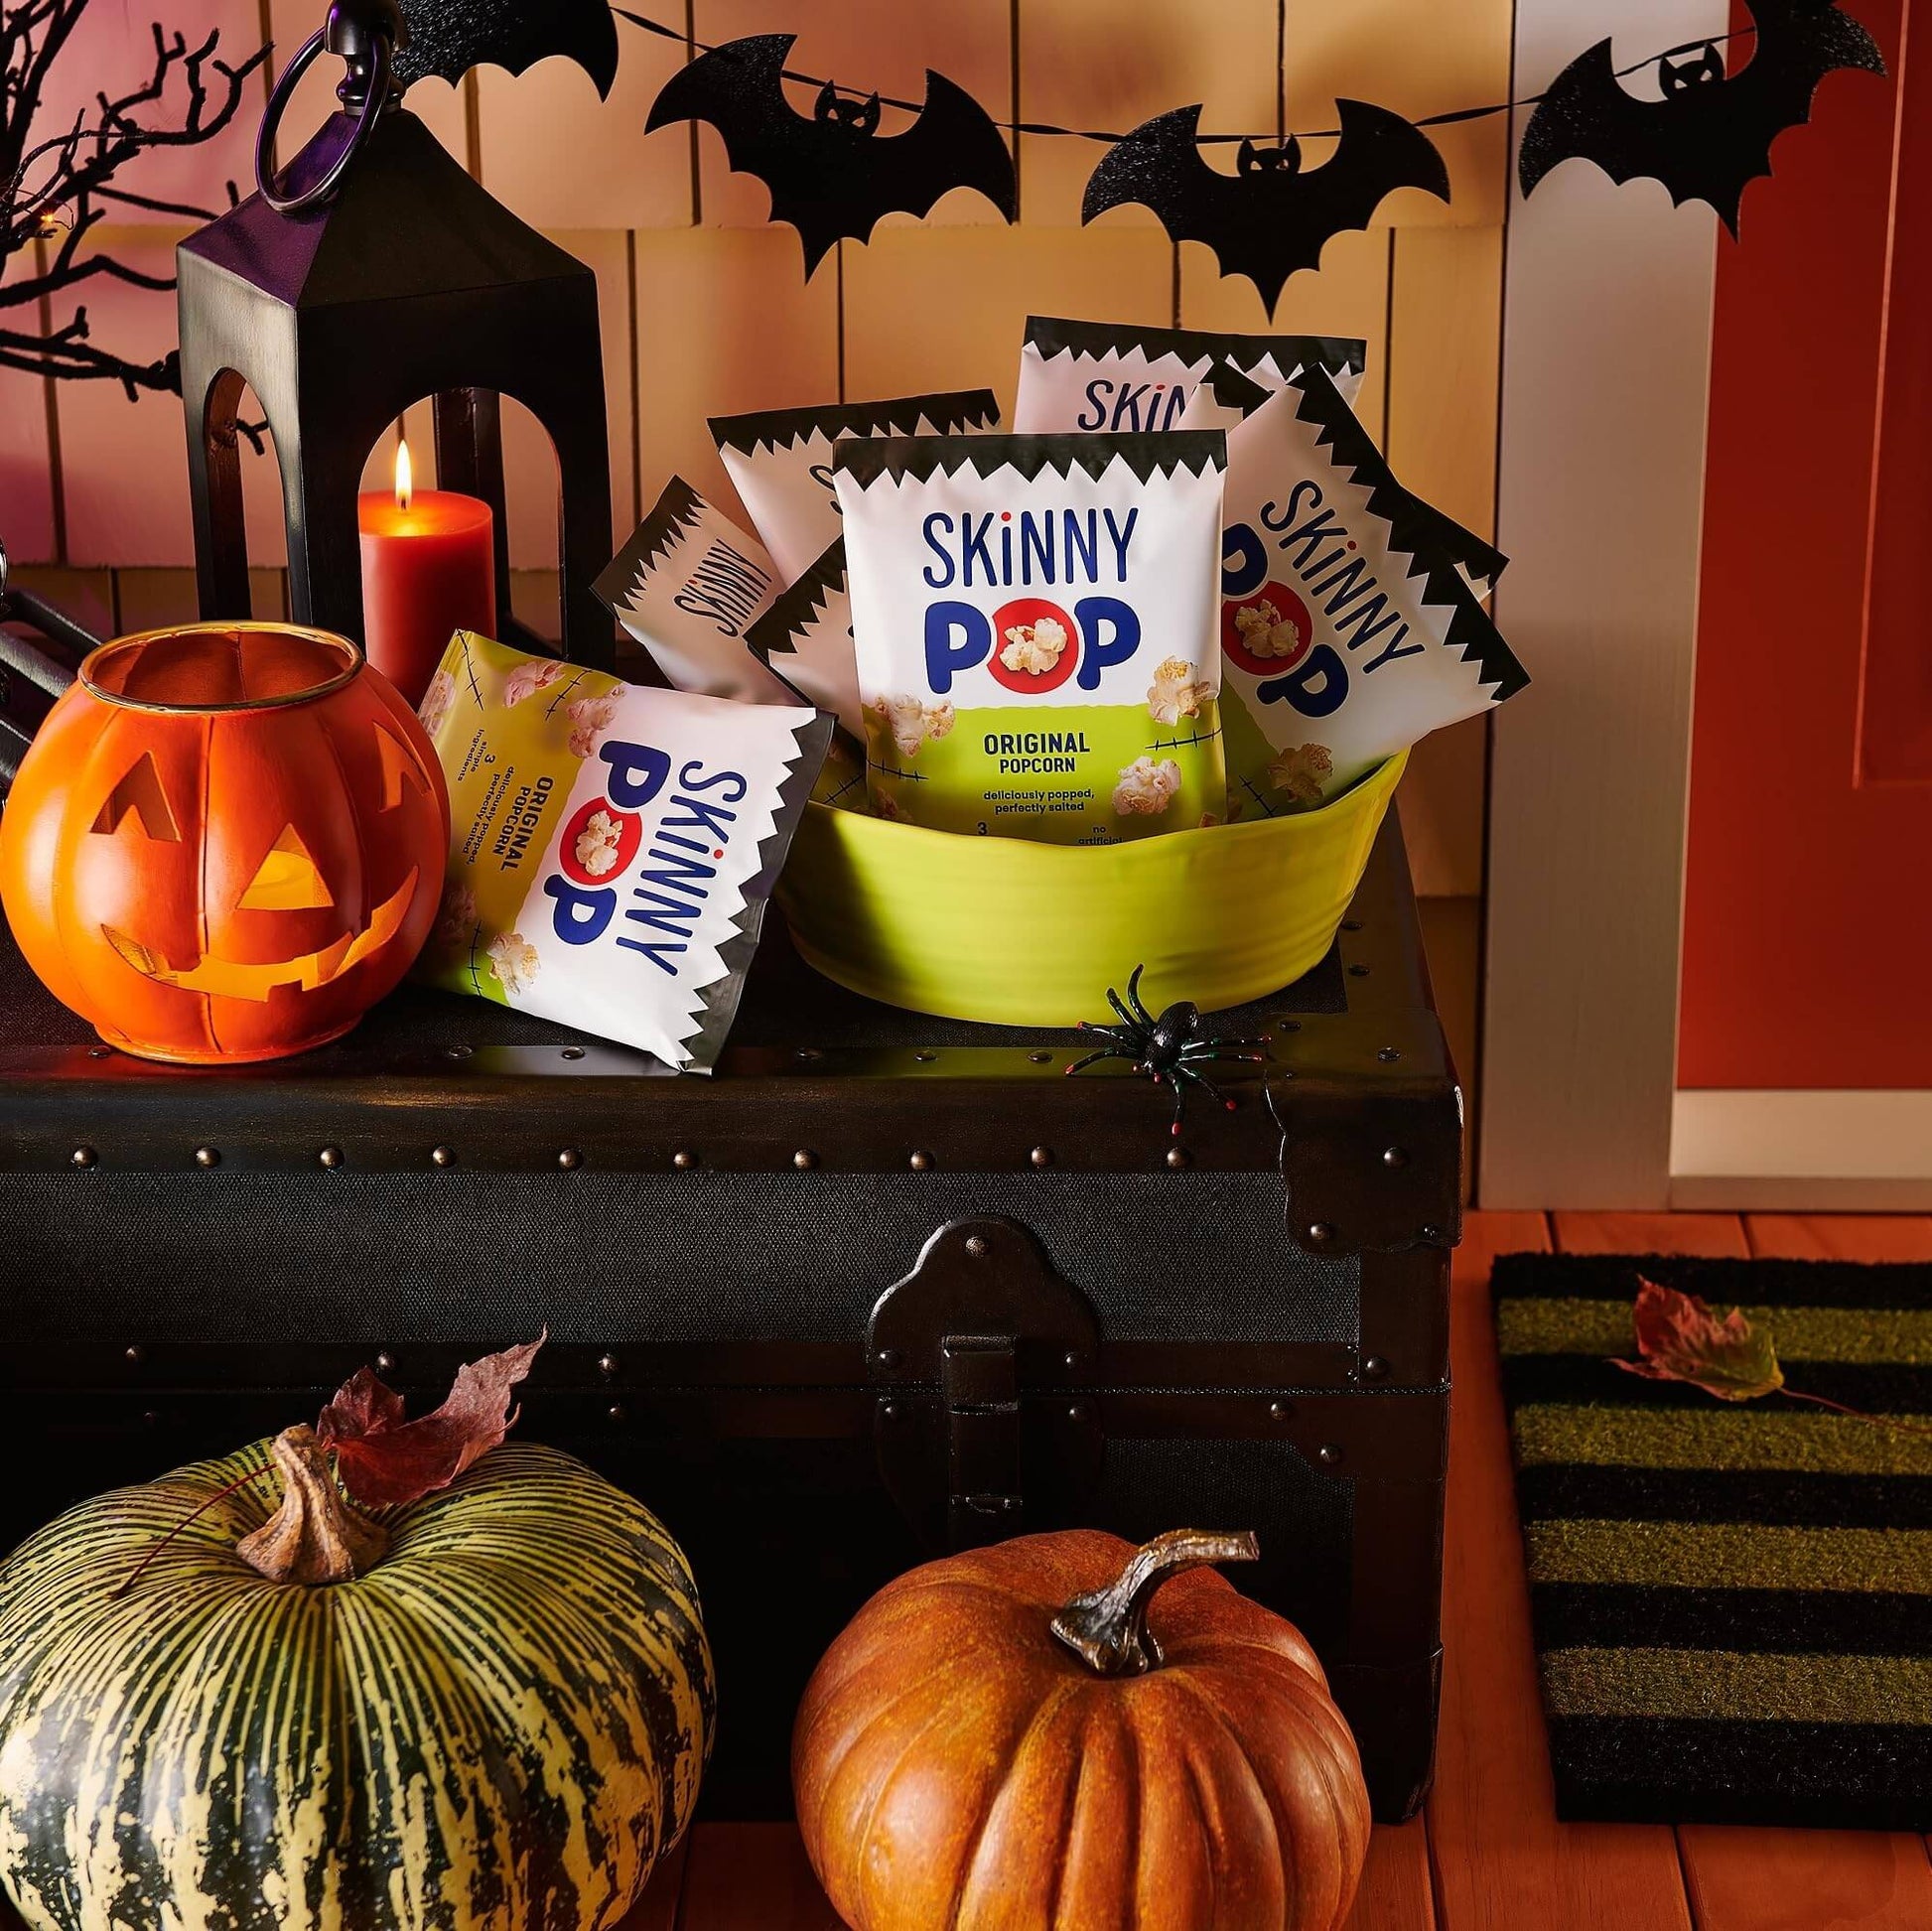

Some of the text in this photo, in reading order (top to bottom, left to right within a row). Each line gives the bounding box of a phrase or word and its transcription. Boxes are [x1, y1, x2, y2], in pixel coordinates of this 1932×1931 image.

[1078, 380, 1186, 431] SKiN
[923, 596, 1142, 695] POP
[457, 729, 485, 781] ingredients
[470, 741, 487, 772] simple
[484, 754, 496, 764] 3
[984, 733, 1090, 755] ORIGINAL
[1000, 758, 1075, 773] POPCORN
[462, 773, 500, 855] perfectly salted
[467, 765, 515, 866] deliciously popped,
[492, 786, 531, 855] POPCORN
[984, 789, 1094, 801] deliciously popped,
[995, 802, 1084, 815] perfectly salted
[500, 776, 554, 872] ORIGINAL
[543, 740, 672, 945] POP
[977, 822, 988, 835] 3
